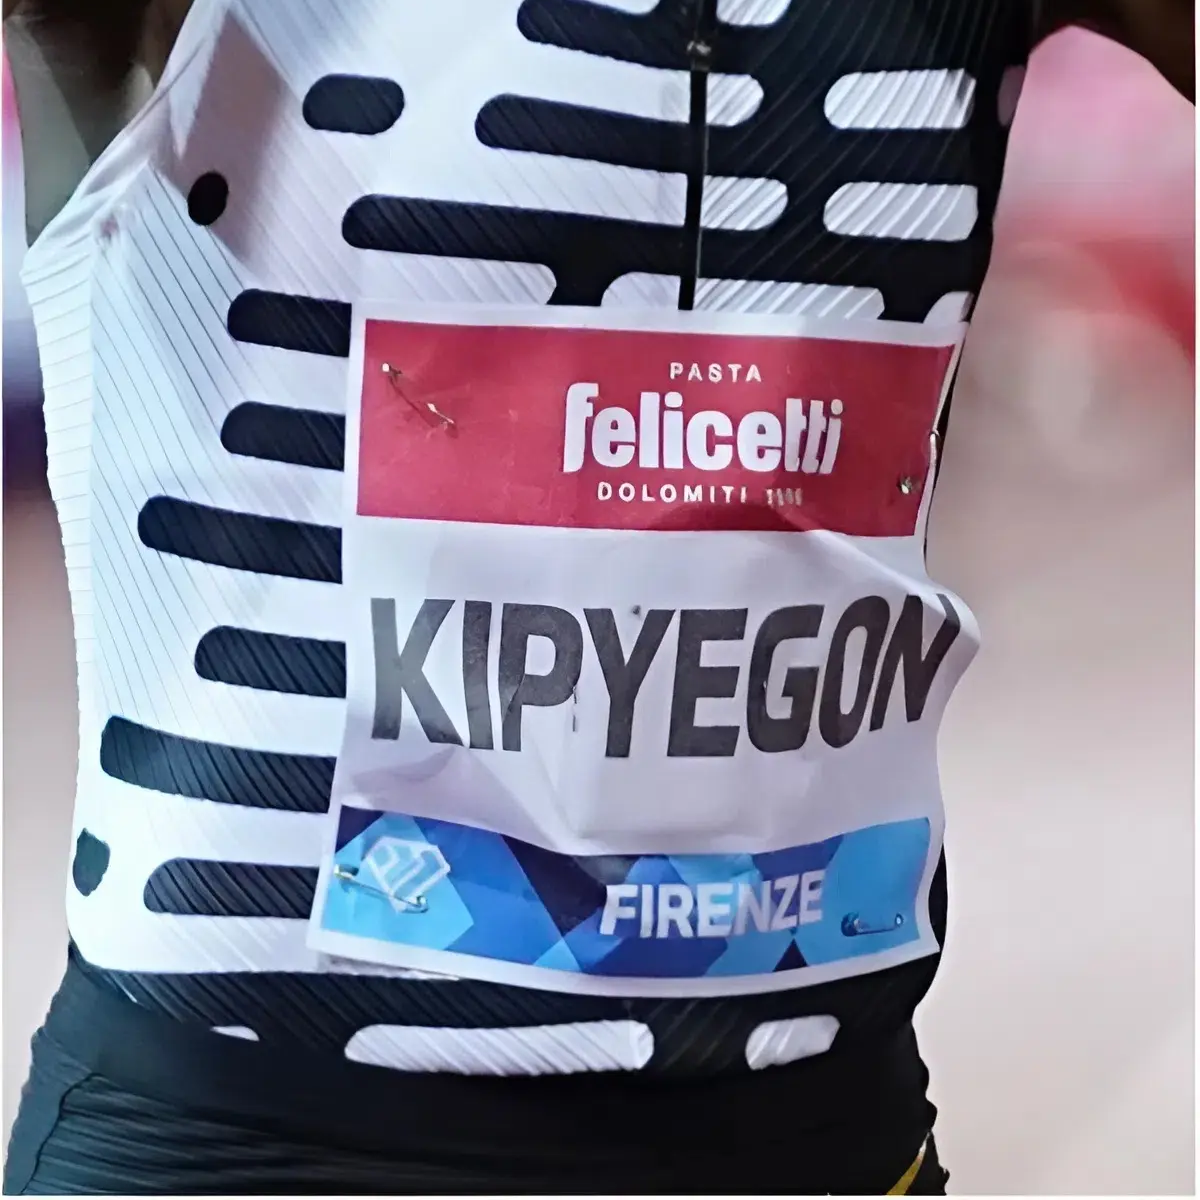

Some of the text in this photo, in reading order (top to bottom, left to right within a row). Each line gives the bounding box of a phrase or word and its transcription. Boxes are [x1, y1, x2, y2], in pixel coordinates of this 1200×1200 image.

[670, 362, 762, 383] PASTA
[563, 382, 844, 475] felicetti
[597, 481, 748, 504] DOLOMITI
[370, 594, 960, 758] KIPYEGON
[601, 870, 824, 938] FIRENZE
